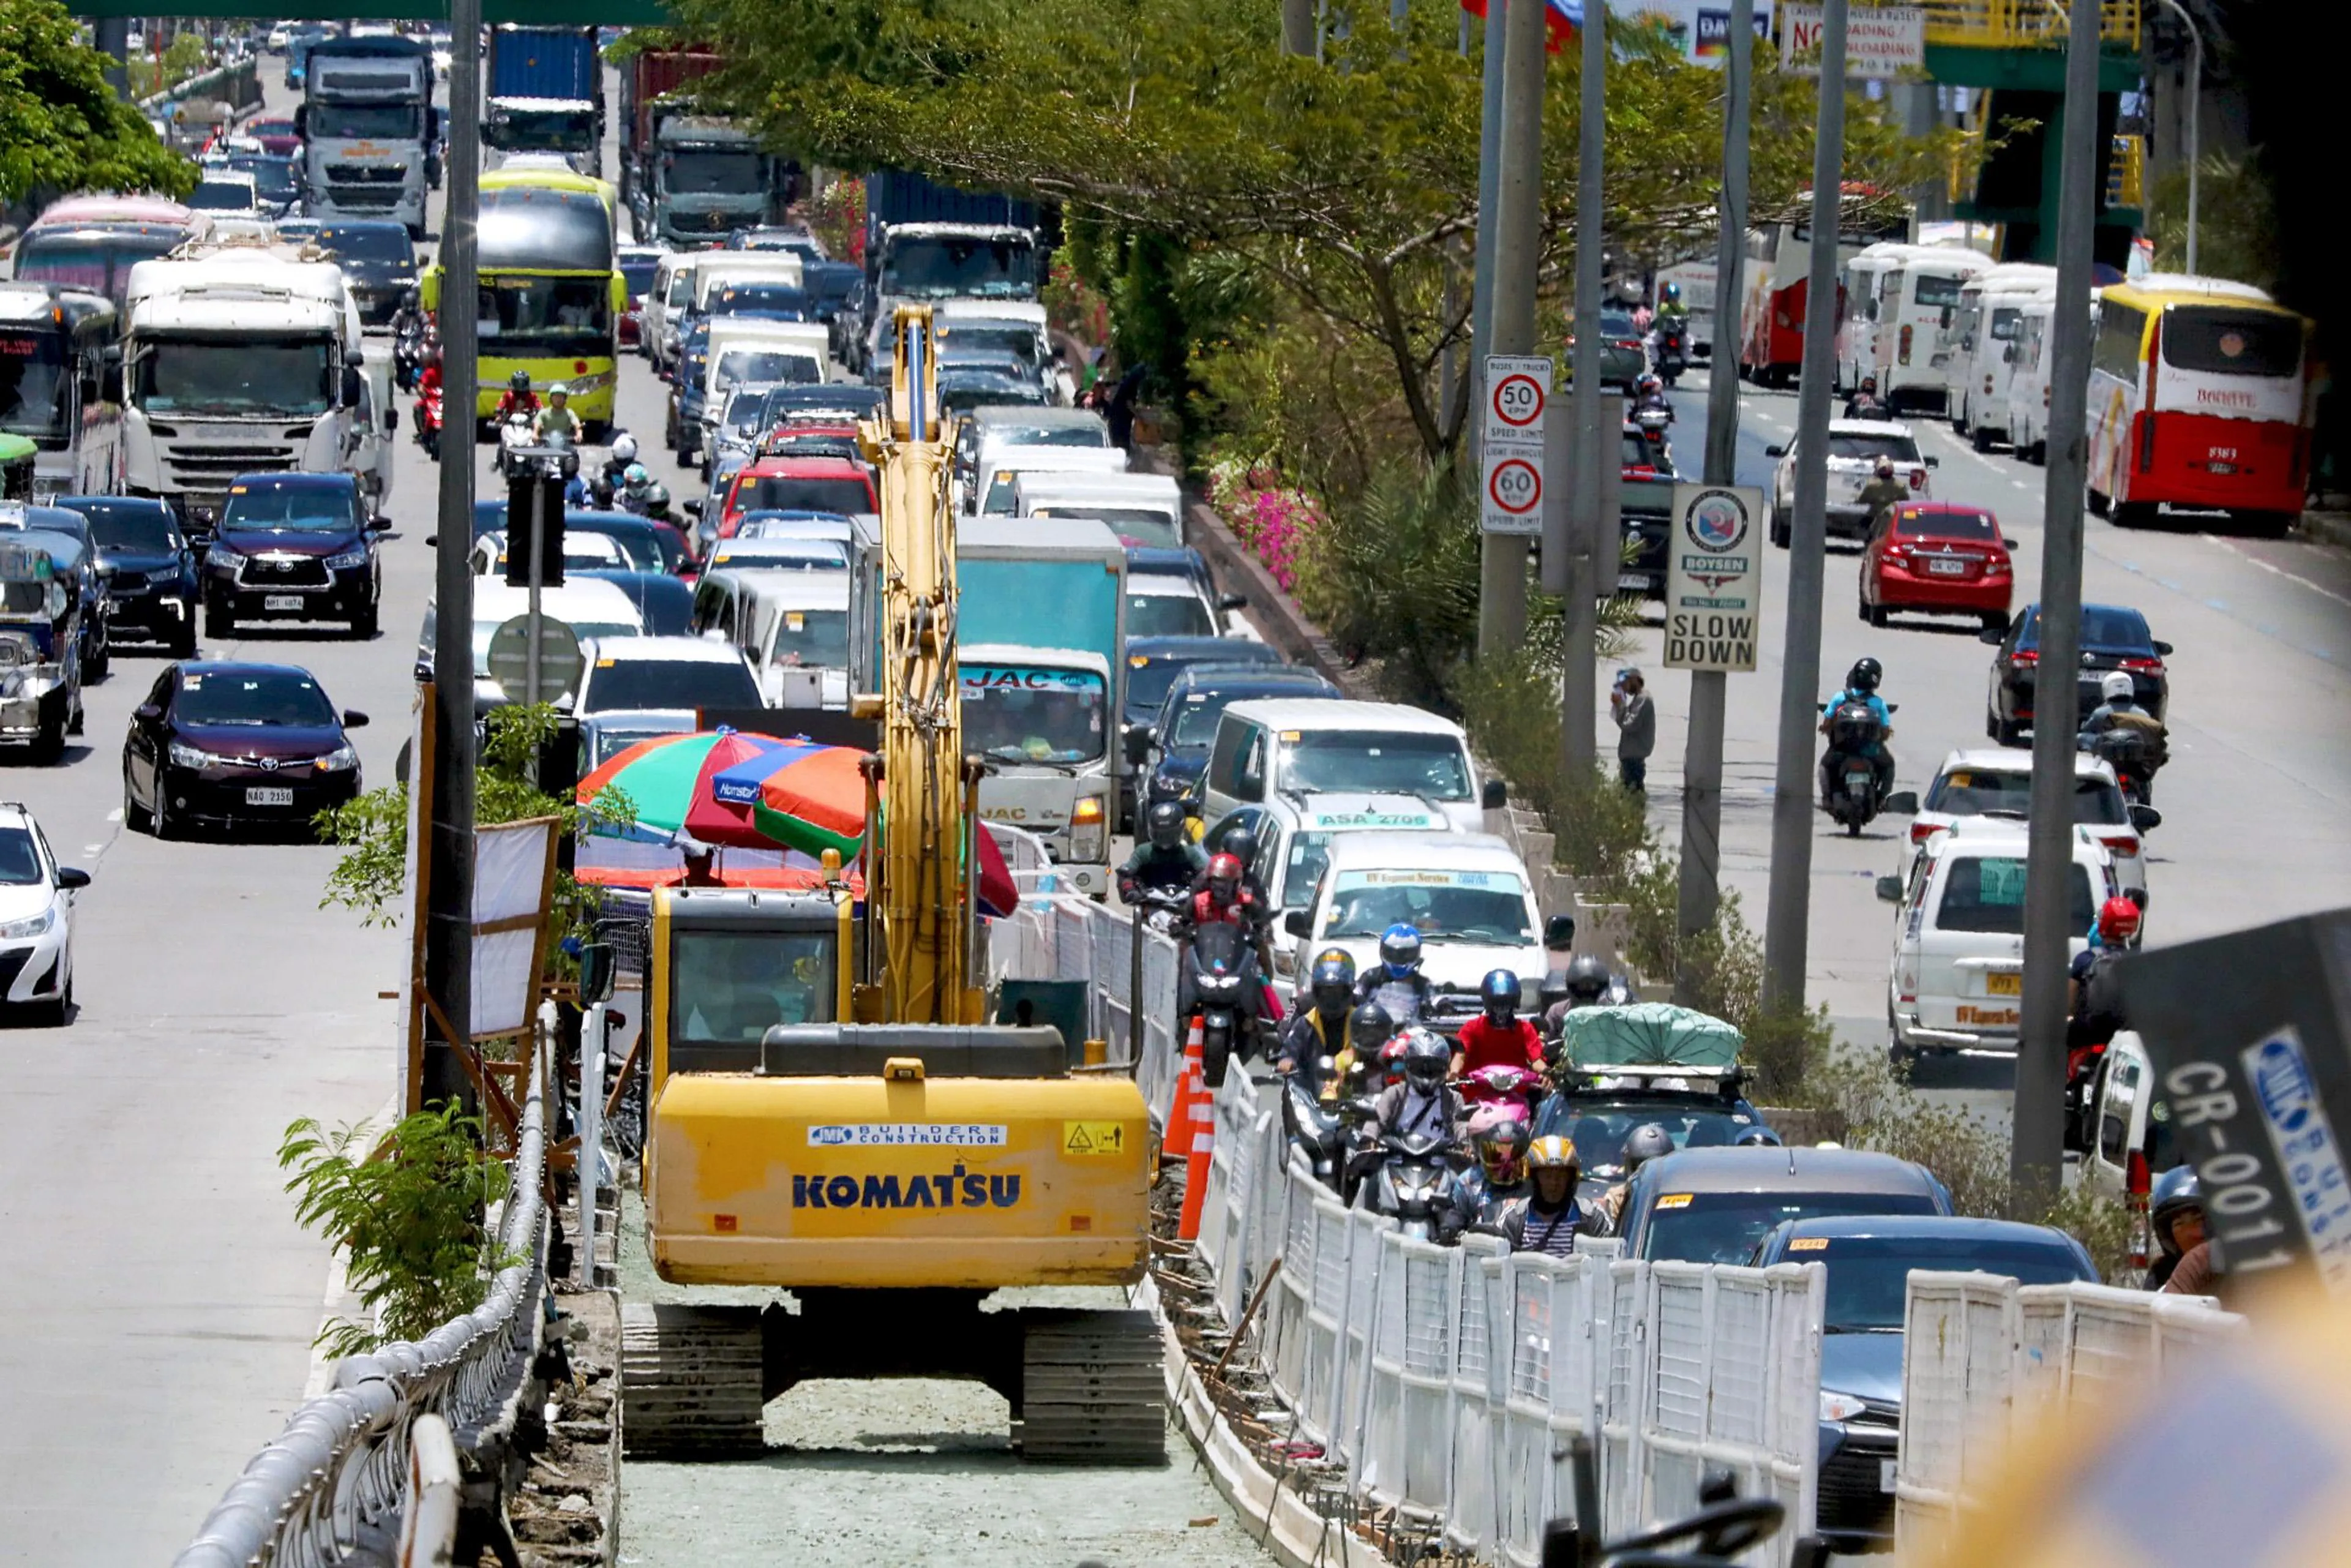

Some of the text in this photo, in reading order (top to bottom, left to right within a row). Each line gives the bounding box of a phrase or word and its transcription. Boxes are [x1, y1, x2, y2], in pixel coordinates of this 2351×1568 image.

[1847, 24, 1895, 37] OADING
[1504, 386, 1532, 404] 50
[1491, 428, 1516, 437] SPEED
[1501, 471, 1531, 492] 60
[1519, 516, 1540, 526] LIMIT
[1687, 558, 1744, 570] BOYSEN
[1673, 614, 1752, 639] SLOW
[1670, 639, 1752, 664] DOWN
[966, 670, 1052, 689] JAC
[979, 808, 1026, 819] JAC
[1322, 814, 1368, 825] ASA
[816, 1125, 999, 1143] JMK BUILDERS
[860, 1135, 999, 1144] CONSTRUCTION
[2165, 1060, 2295, 1272] CR-0011
[792, 1165, 1021, 1208] KOMATSU
